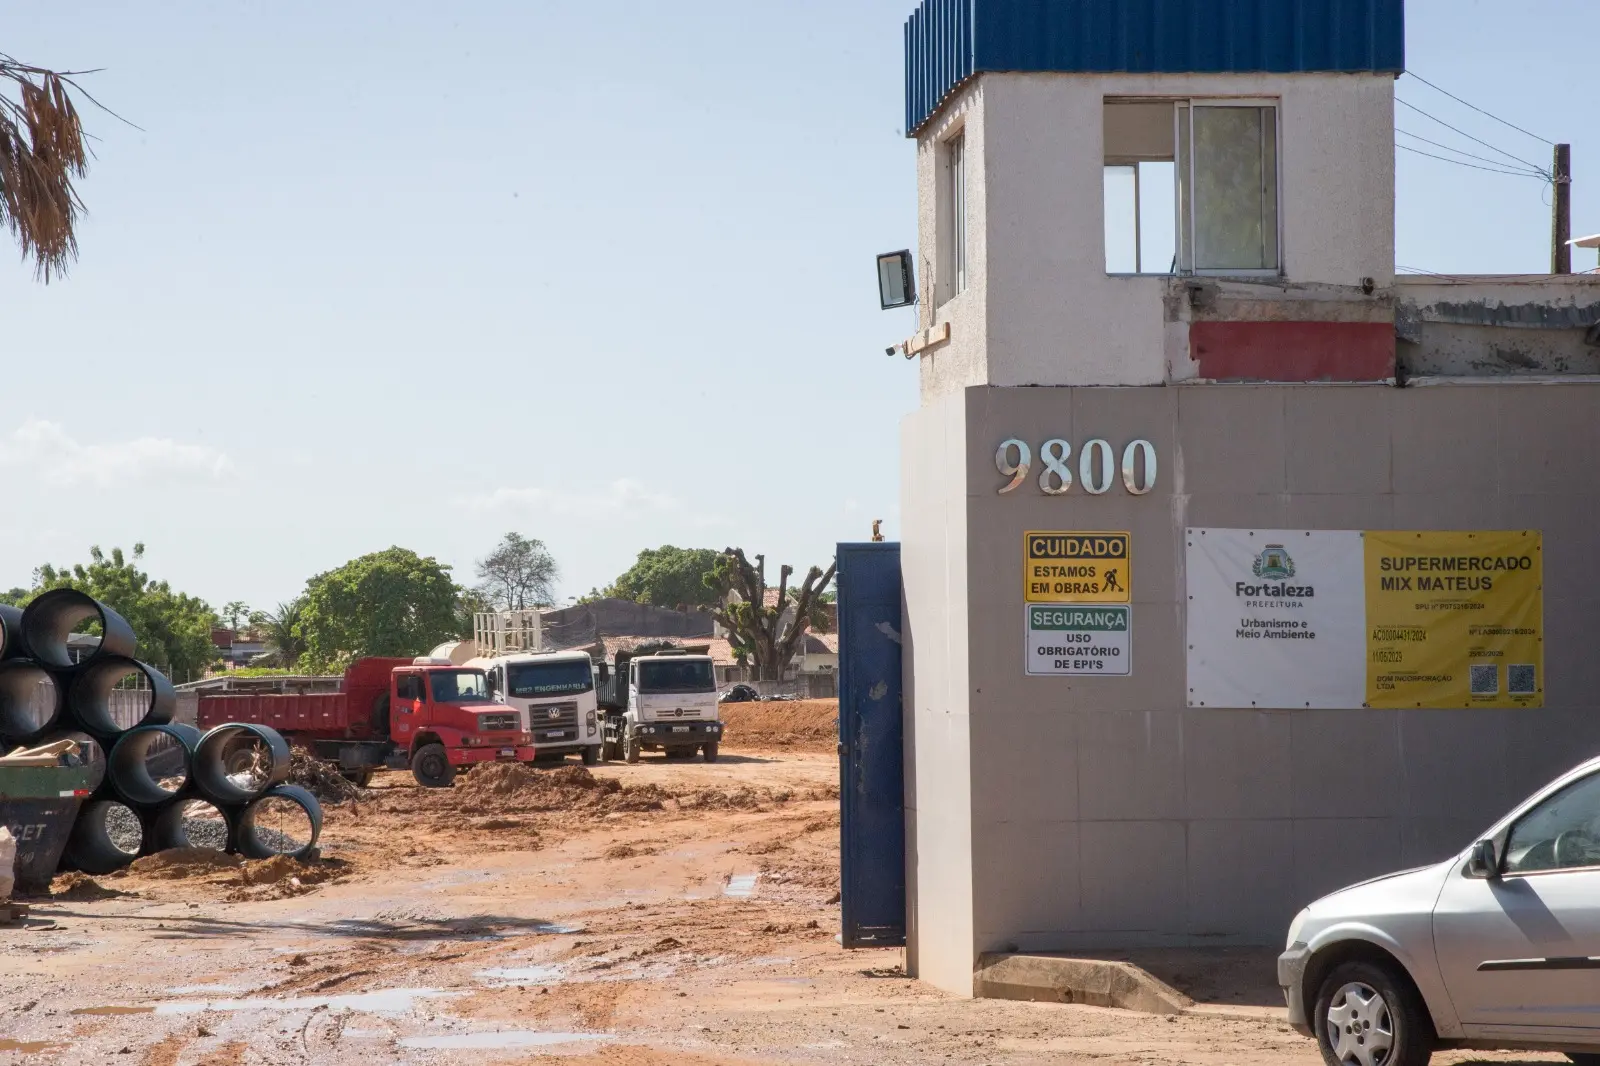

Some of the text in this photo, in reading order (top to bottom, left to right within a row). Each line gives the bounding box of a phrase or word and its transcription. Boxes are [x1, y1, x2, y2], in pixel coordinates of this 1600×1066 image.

[995, 438, 1157, 496] 9800
[1032, 539, 1124, 556] CUIDADO
[1380, 556, 1532, 571] SUPERMERCADO
[1034, 566, 1096, 578] ESTAMOS
[1031, 583, 1099, 594] EM OBRAS
[1236, 581, 1314, 597] Fortaleza
[1381, 576, 1492, 591] MIX MATEUS
[1033, 611, 1125, 629] SEGURANÇA
[1241, 618, 1298, 628] Urbanismo
[1066, 634, 1091, 643] USO
[1236, 629, 1315, 639] Meio Ambiente
[1037, 645, 1120, 656] OBRIGATÓRIO
[1055, 660, 1103, 669] DE EPI'S
